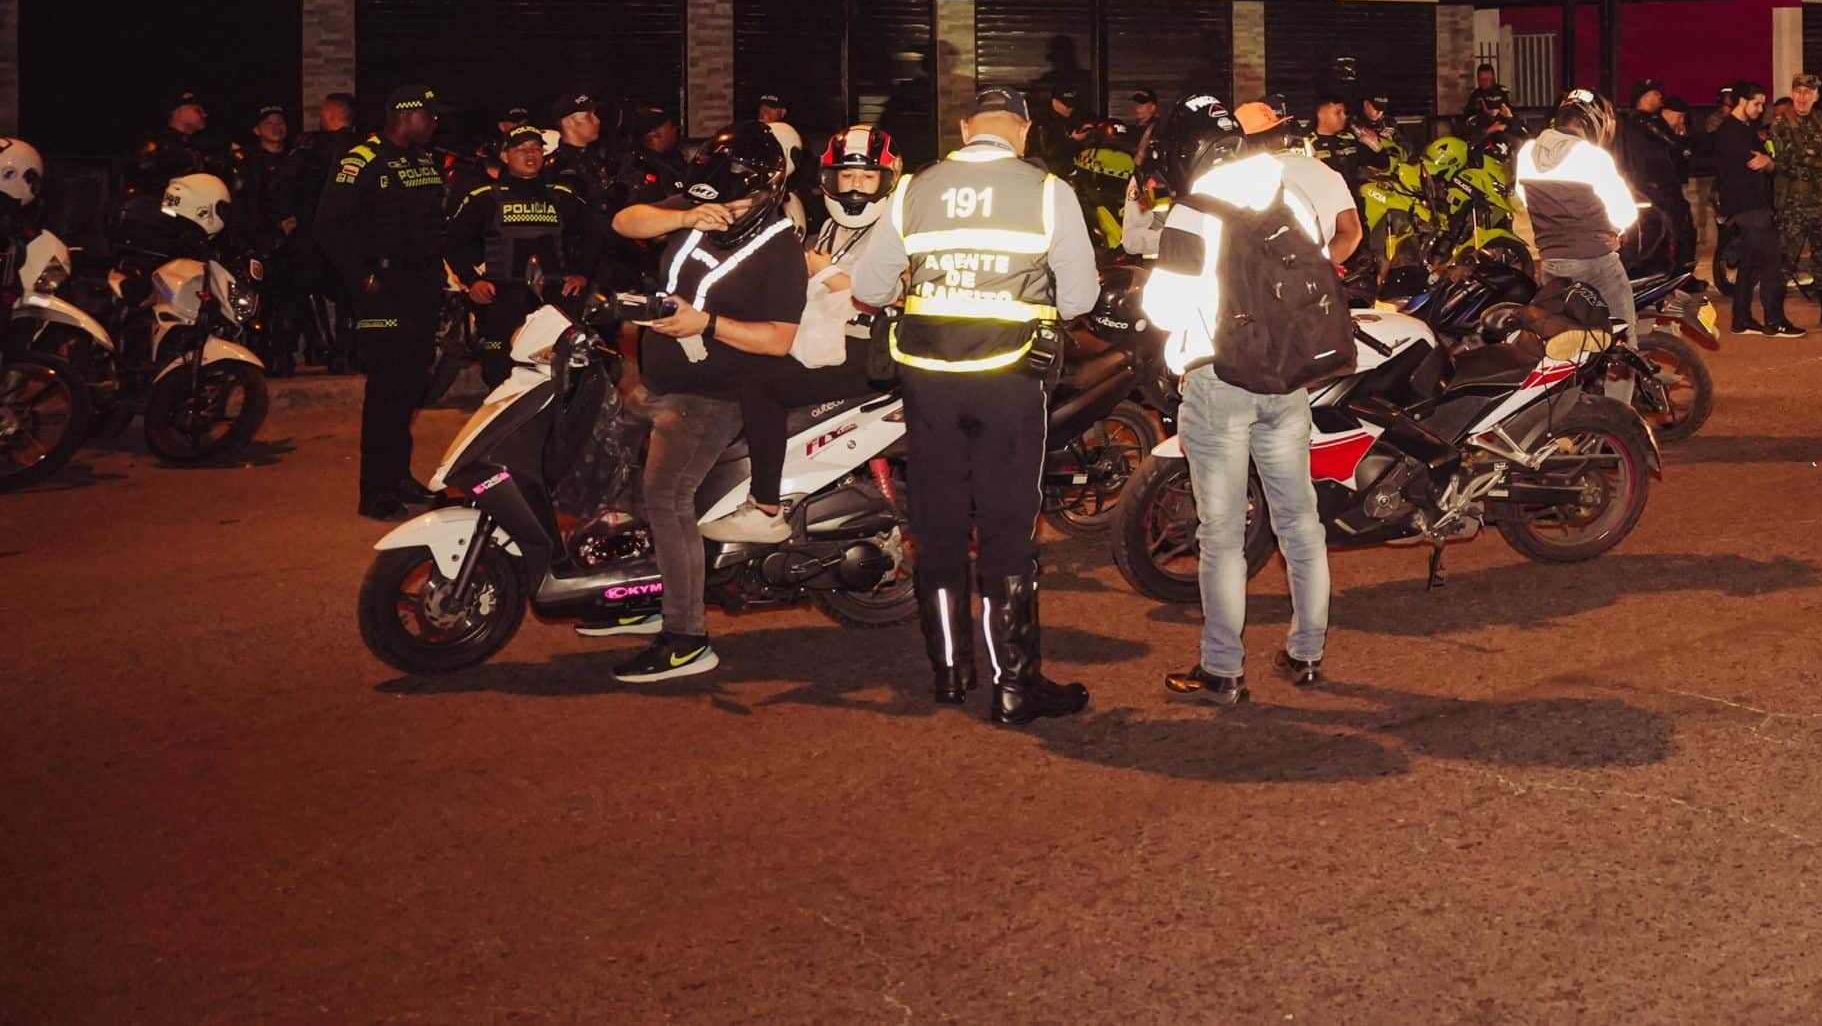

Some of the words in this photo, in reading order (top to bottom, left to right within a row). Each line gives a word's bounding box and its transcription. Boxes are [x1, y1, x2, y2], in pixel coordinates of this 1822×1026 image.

[940, 186, 994, 219] 191
[924, 253, 1011, 274] AGENTE
[945, 269, 977, 289] DE
[628, 582, 663, 595] KYM
